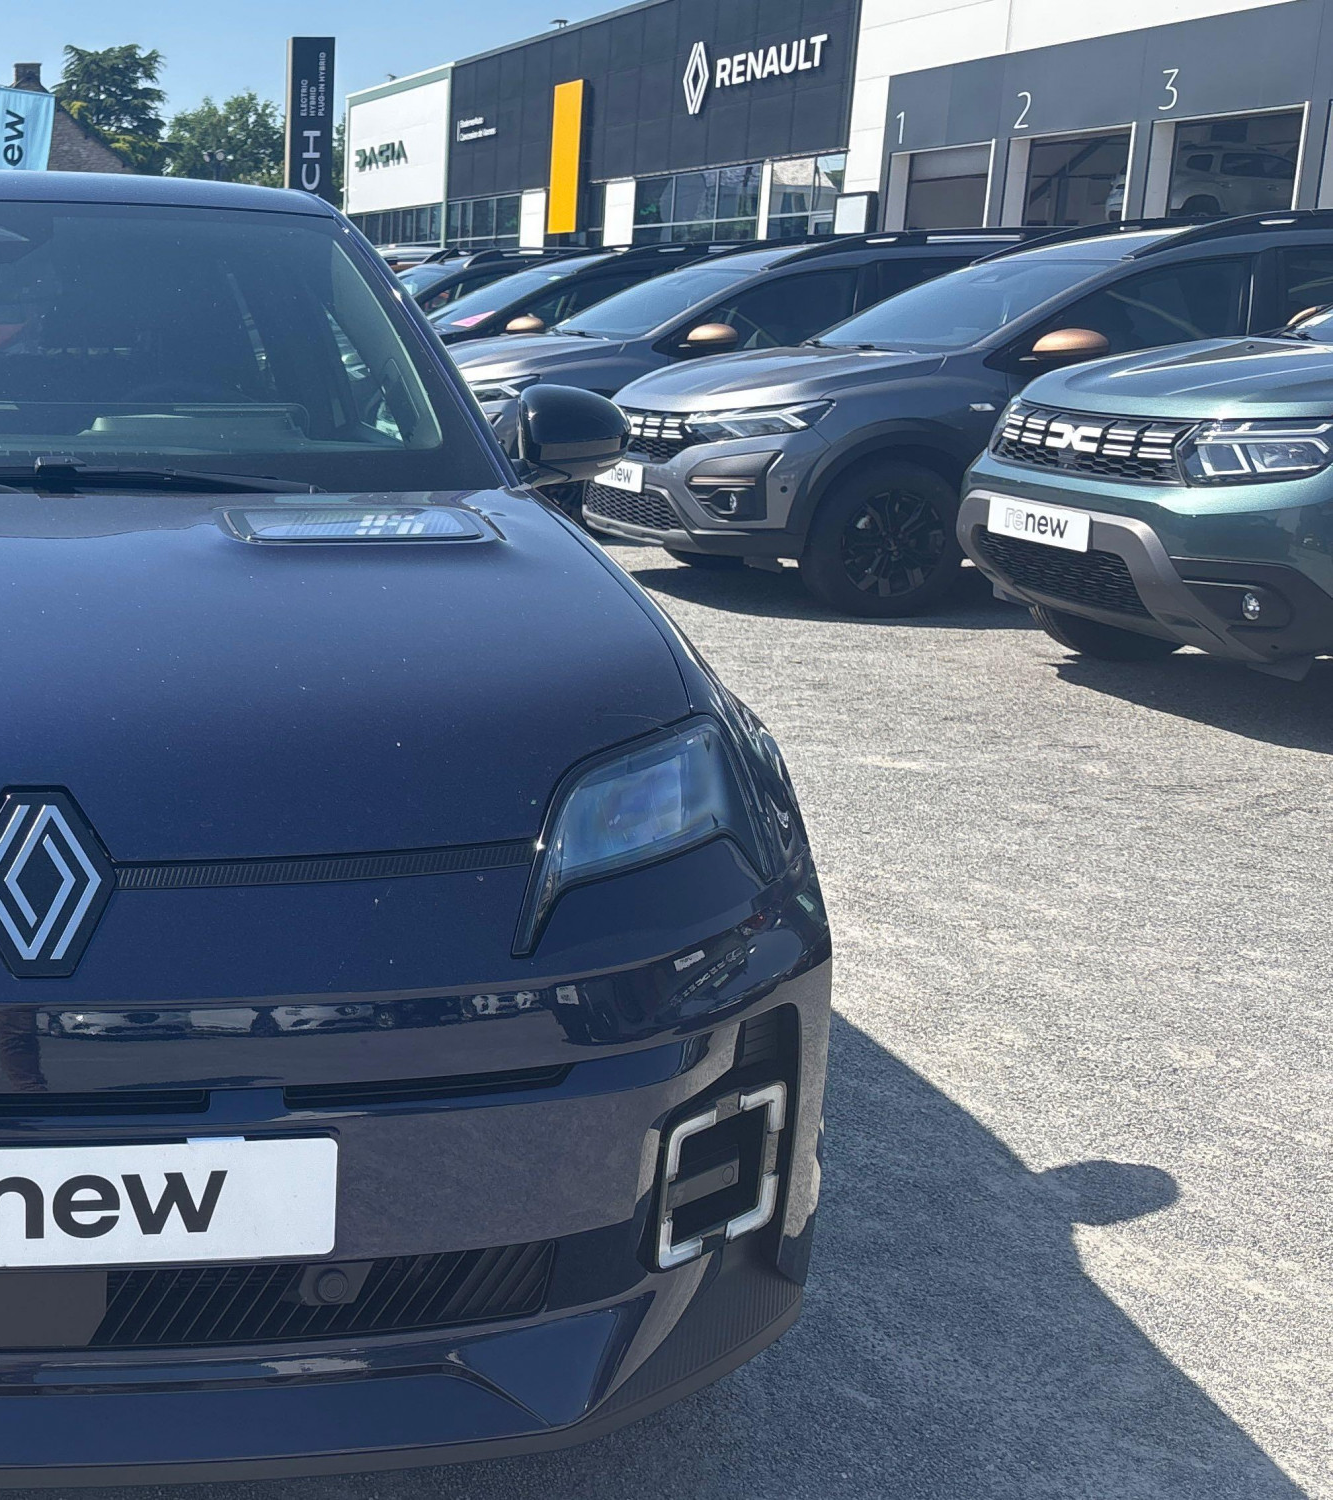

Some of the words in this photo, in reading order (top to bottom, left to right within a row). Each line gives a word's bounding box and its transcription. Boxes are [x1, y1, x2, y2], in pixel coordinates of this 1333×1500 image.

[319, 51, 327, 82] HYBRID
[715, 33, 828, 88] RENAULT
[300, 79, 308, 117] ELECTRIC
[309, 86, 317, 117] HYBRID
[318, 83, 326, 117] PLUG-IN
[1157, 68, 1180, 110] 3
[896, 111, 905, 144] 1
[1013, 92, 1031, 129] 2
[301, 130, 321, 191] CH
[1004, 507, 1069, 539] renew
